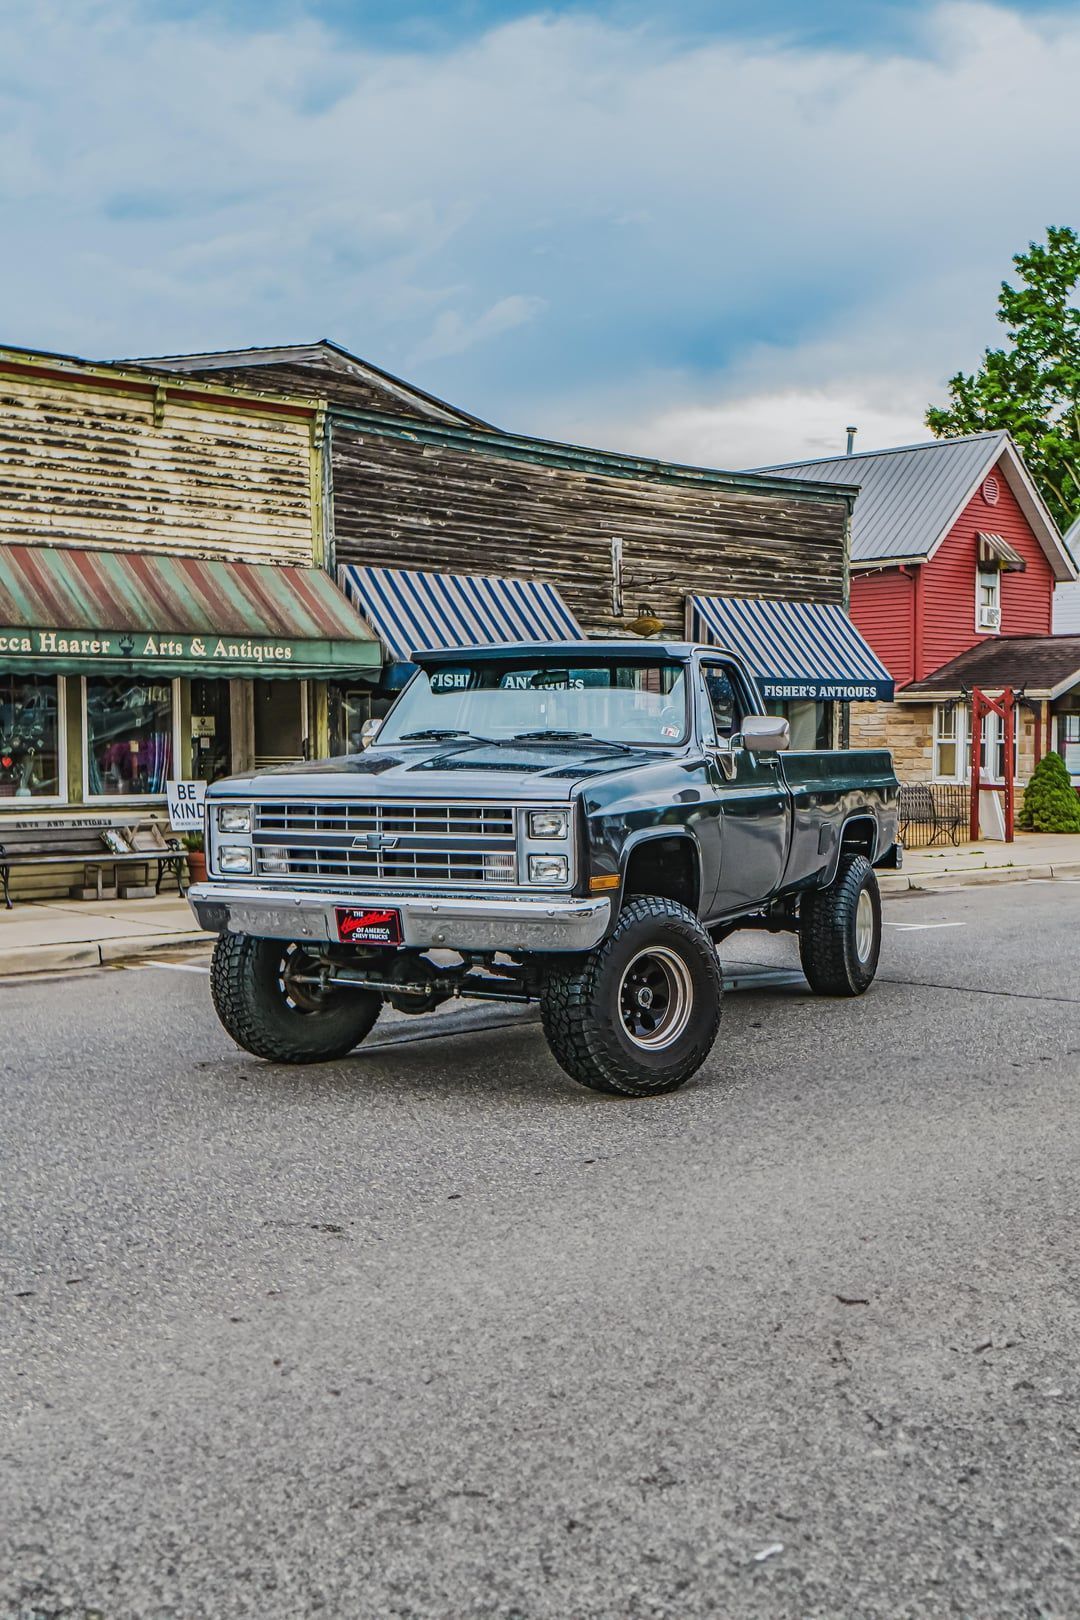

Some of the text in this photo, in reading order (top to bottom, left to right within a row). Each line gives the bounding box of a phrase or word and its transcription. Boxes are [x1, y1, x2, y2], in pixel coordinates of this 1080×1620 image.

[39, 632, 110, 654] Haarer
[143, 637, 183, 656] Arts
[190, 638, 207, 657] &
[213, 639, 292, 662] Antiques
[764, 685, 877, 698] FISHER'S ANTIQUES
[177, 784, 197, 800] BE
[171, 802, 205, 819] KIND
